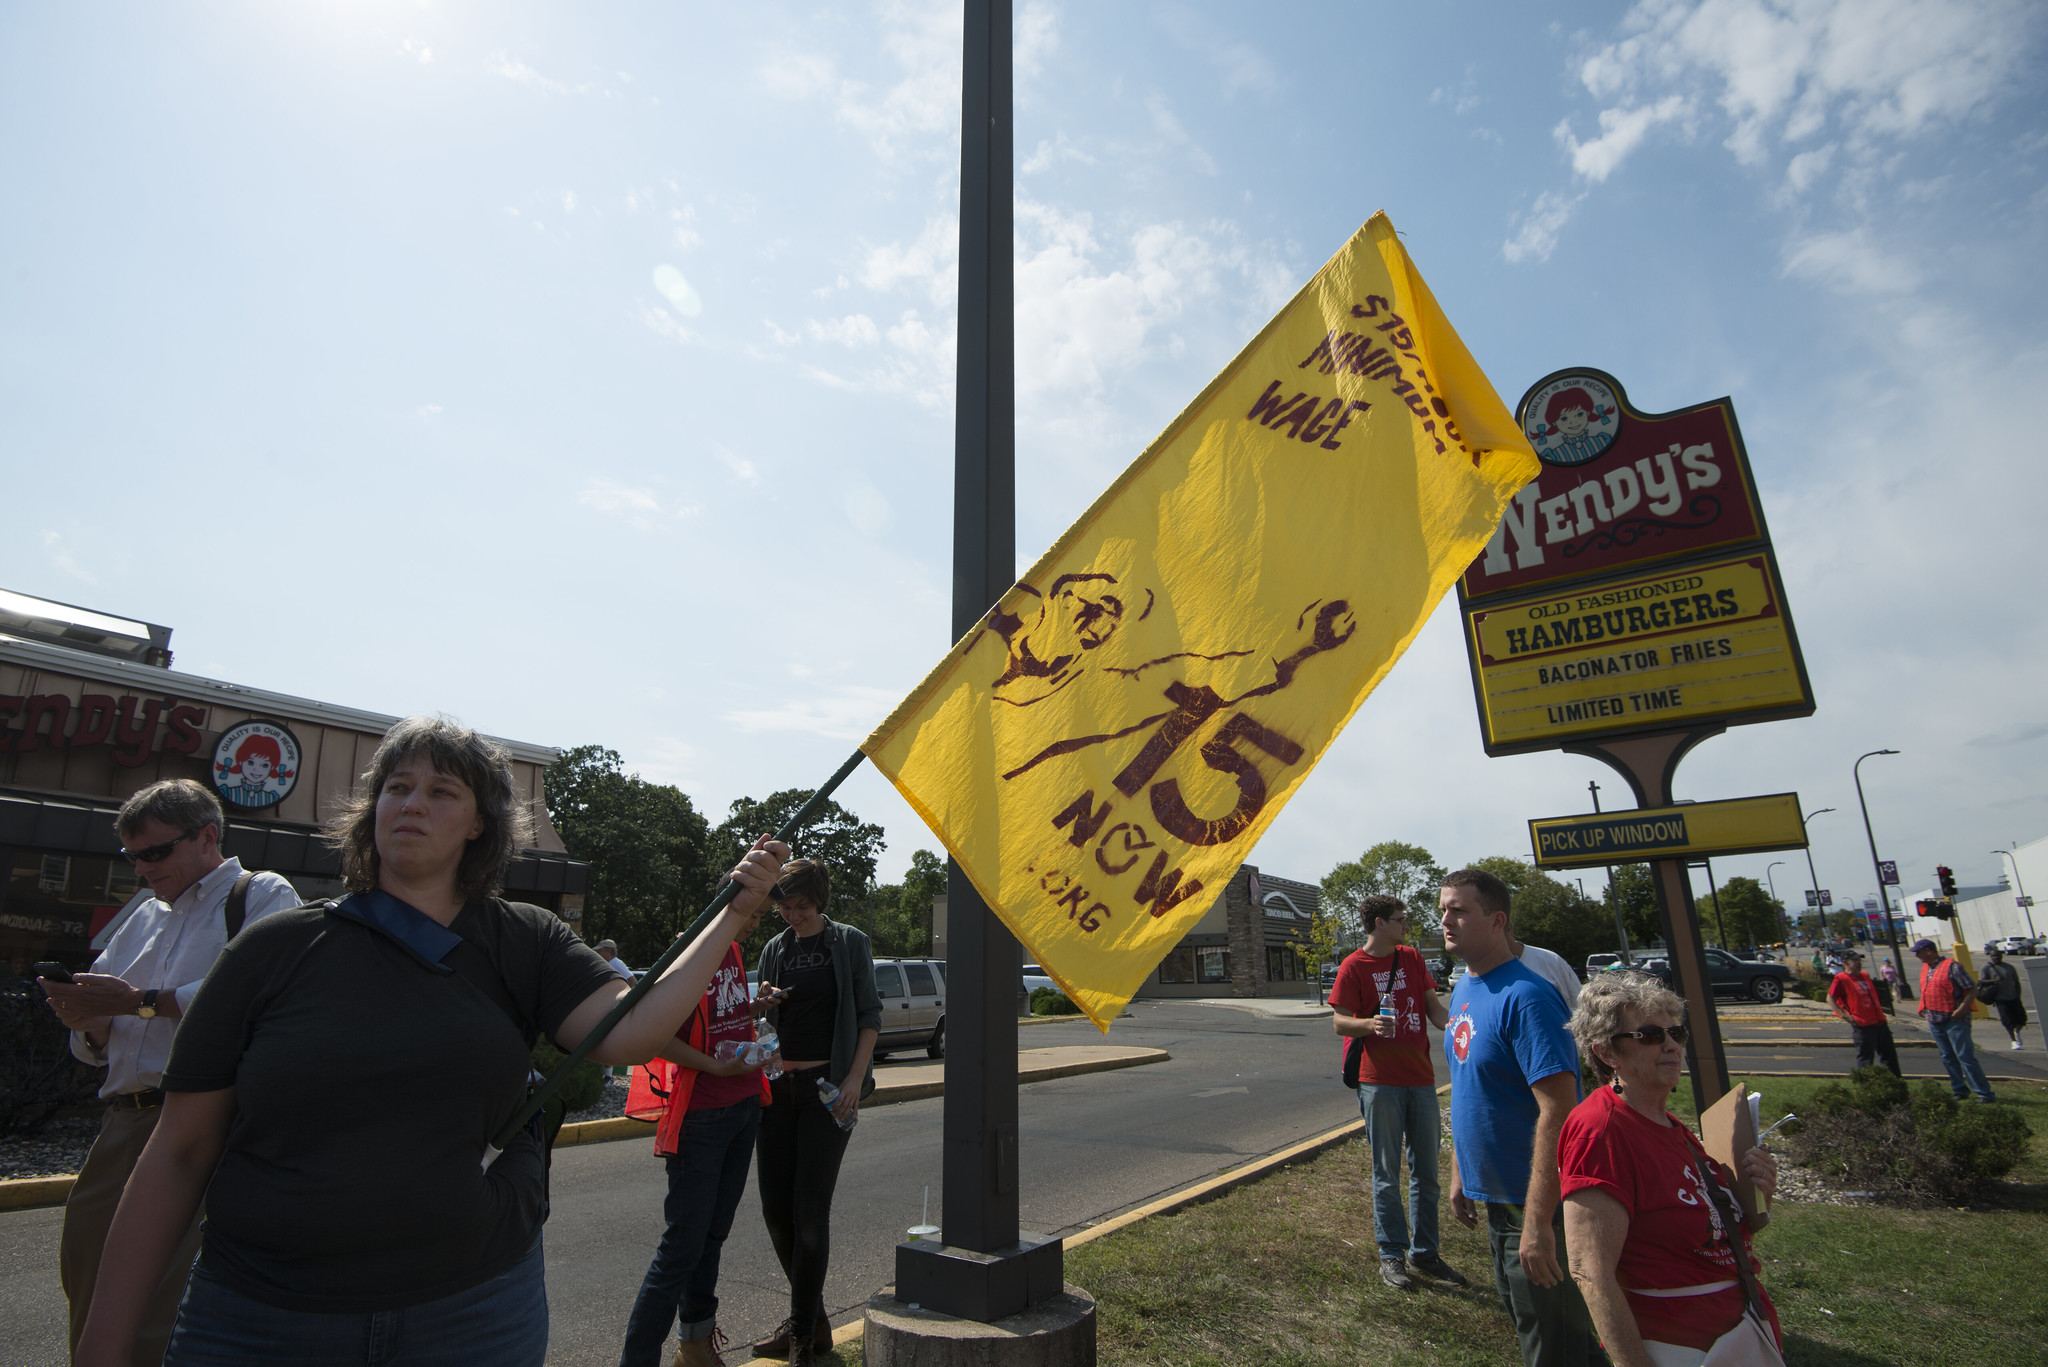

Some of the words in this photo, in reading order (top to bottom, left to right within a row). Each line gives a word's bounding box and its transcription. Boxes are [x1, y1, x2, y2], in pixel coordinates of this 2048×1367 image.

[1248, 380, 1372, 451] WAGE
[1529, 390, 1549, 419] QUALITY
[1552, 384, 1560, 392] IS
[1562, 379, 1581, 387] OUR
[1583, 380, 1609, 398] RECIPE
[1528, 600, 1571, 620] OLD
[1577, 575, 1704, 611] FASHIONED
[1505, 587, 1739, 655] HAMBURGERS
[1538, 649, 1660, 685] BACONATOR
[1670, 637, 1733, 665] FRIES
[1547, 696, 1625, 725] LIMITED
[1629, 688, 1682, 712] TIME
[221, 727, 249, 752] QUALITY
[263, 727, 282, 739] OUR
[280, 736, 295, 761] RECIPE
[1112, 680, 1305, 847] 15
[1051, 789, 1203, 919] NOW
[1540, 831, 1580, 852] PICK
[1582, 828, 1606, 848] UP
[1608, 820, 1684, 845] WINDOW
[1265, 908, 1281, 918] TACO
[1281, 910, 1296, 920] BELL
[1407, 1012, 1420, 1025] 15
